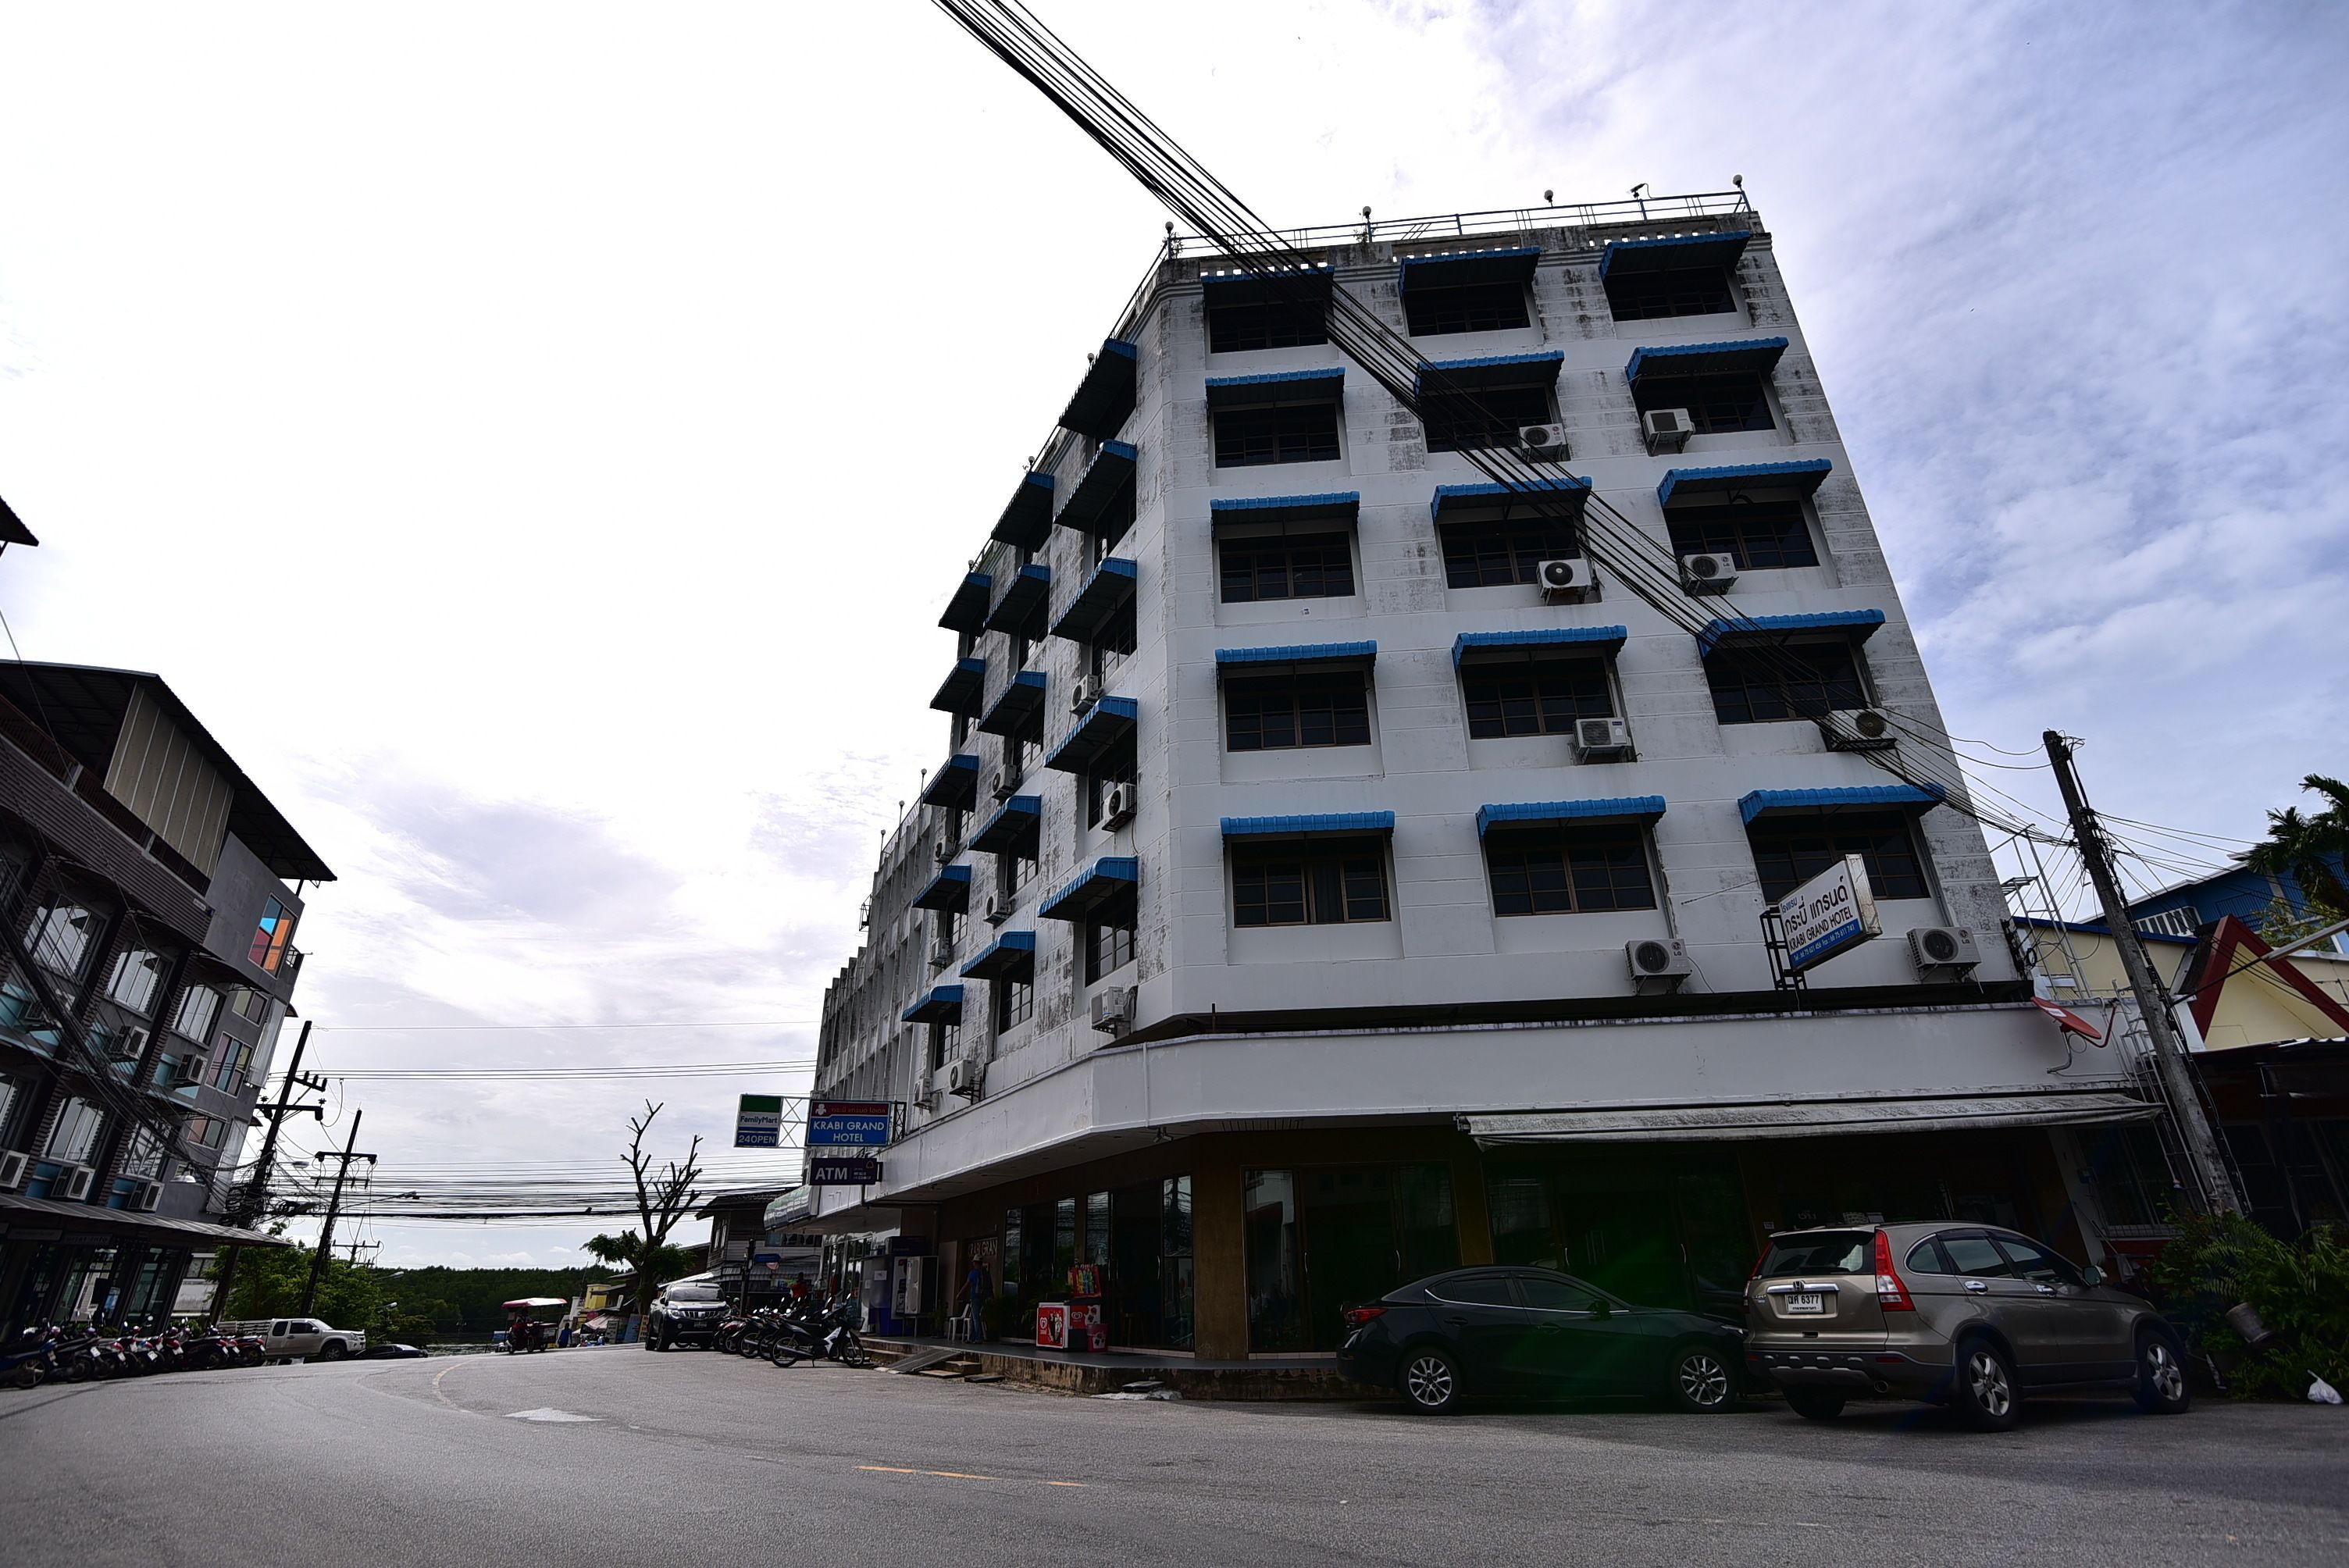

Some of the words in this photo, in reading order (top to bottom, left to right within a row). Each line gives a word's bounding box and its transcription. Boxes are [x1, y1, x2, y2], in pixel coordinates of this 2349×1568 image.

[1785, 896, 1807, 935] กระบี่
[1809, 875, 1848, 919] แกรนด์
[1788, 932, 1806, 951] KRABI
[1806, 919, 1829, 941] GRAND
[1829, 906, 1853, 928] HOTEL
[740, 1115, 778, 1124] FamilyMart
[813, 1121, 844, 1131] KRABI
[847, 1121, 885, 1131] GRAND
[833, 1133, 864, 1142] HOTEL
[815, 1167, 847, 1180] ATM
[1802, 1295, 1819, 1304] 6377
